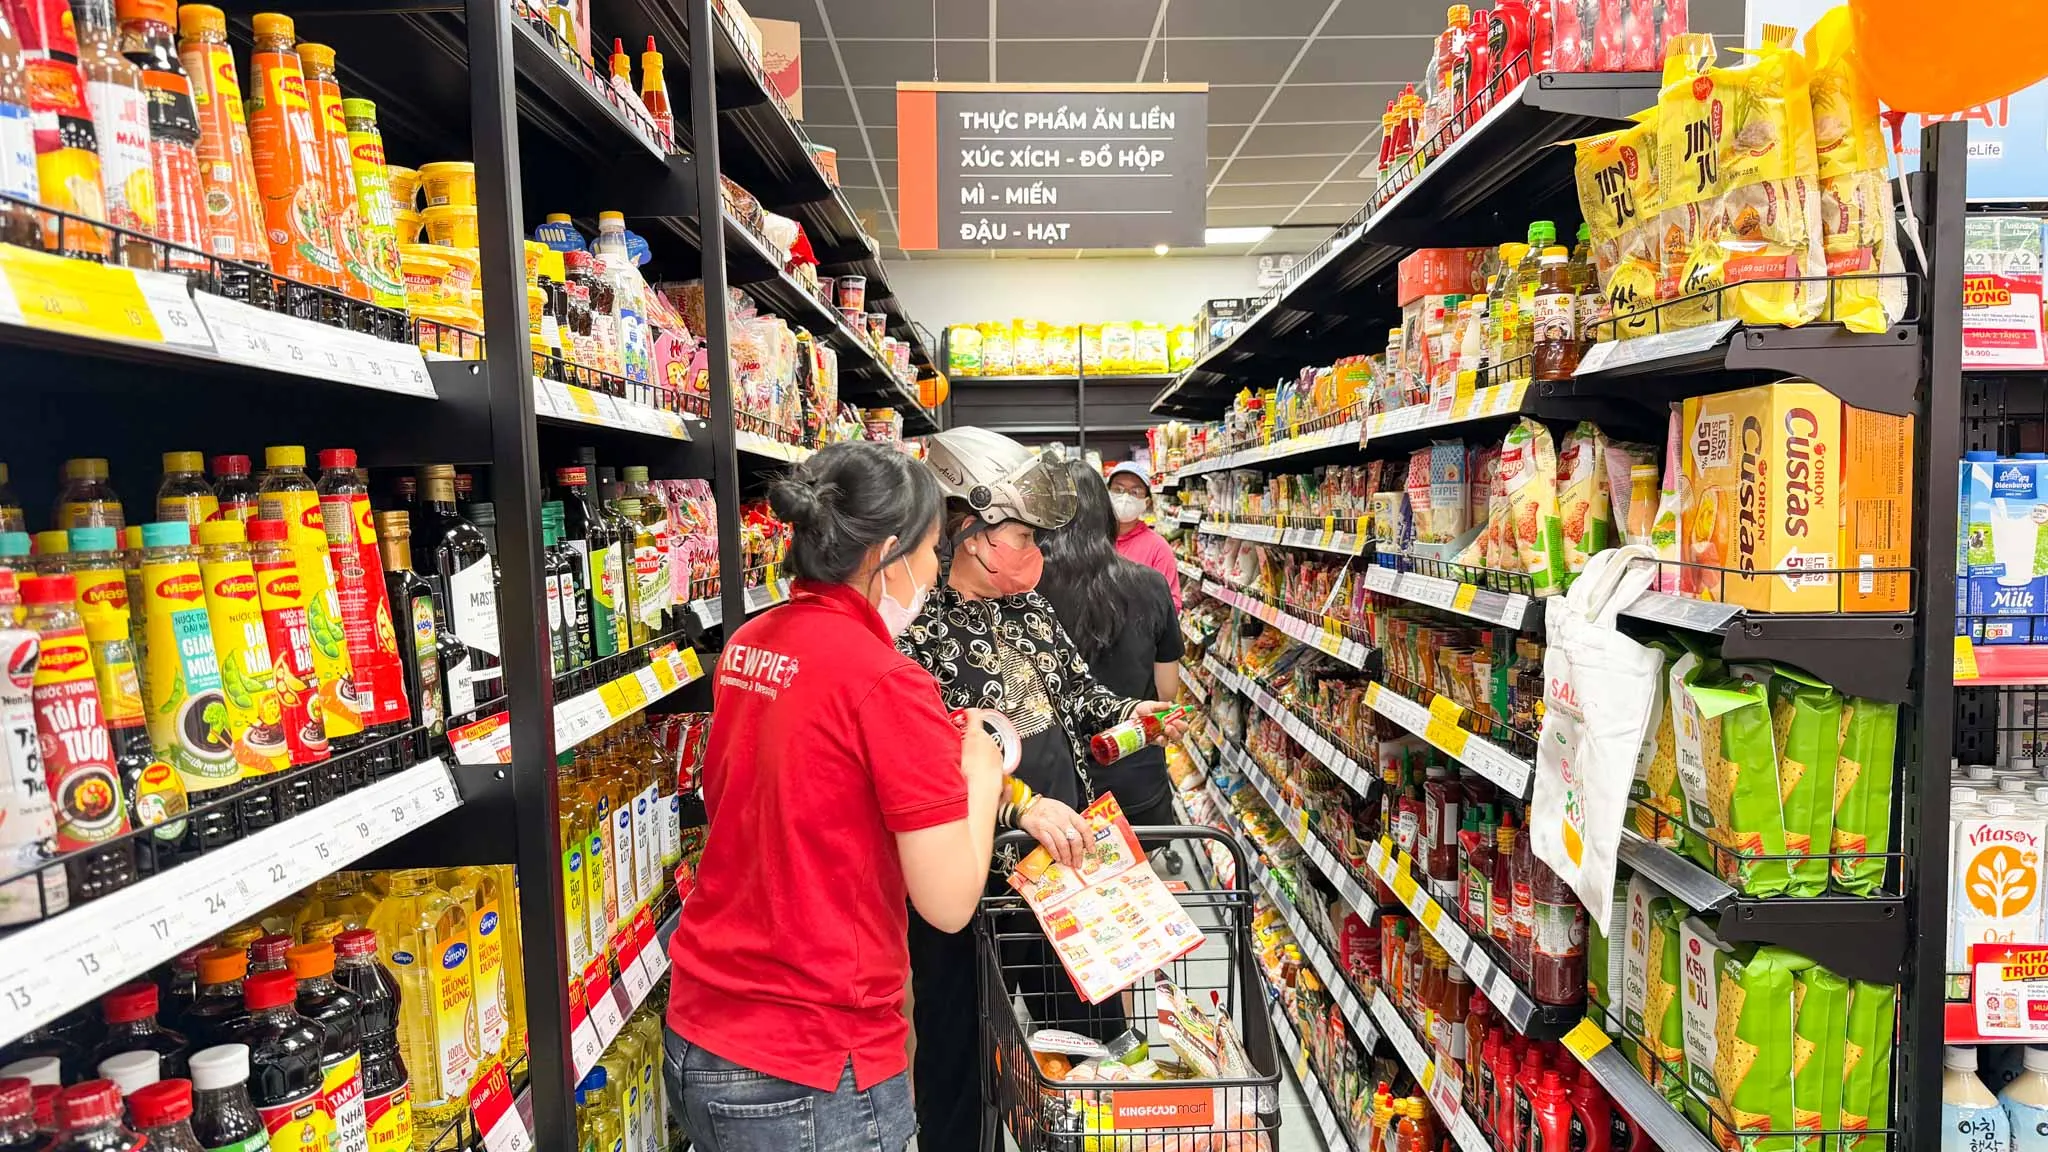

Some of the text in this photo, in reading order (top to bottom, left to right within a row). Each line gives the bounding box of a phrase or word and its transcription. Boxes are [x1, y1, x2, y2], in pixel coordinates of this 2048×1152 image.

[960, 104, 1175, 134] THỰC PHẨM ĂN LIỀN
[1684, 115, 1712, 162] JIN
[960, 145, 1005, 167] XÚC
[1009, 145, 1060, 168] XÍCH
[1079, 143, 1113, 168] ĐỒ
[1118, 144, 1165, 172] HỘP
[1594, 160, 1626, 205] JIN
[1696, 150, 1718, 194] JU
[960, 186, 985, 205] MÌ
[1005, 181, 1057, 205] MIẾN
[1611, 186, 1636, 228] JU
[960, 218, 1007, 245] ĐẬU
[1027, 222, 1071, 245] HẠT
[2010, 253, 2031, 266] A2
[167, 309, 189, 328] 65
[1697, 422, 1711, 470] 50%
[1710, 421, 1718, 461] SUGAR
[1717, 419, 1728, 461] LESS
[1784, 407, 1819, 538] Custas
[1814, 459, 1825, 506] ORION
[1994, 481, 2034, 490] Oldenburger
[1739, 415, 1763, 583] Custas
[1757, 479, 1768, 541] ORION
[1990, 590, 2036, 609] Milk
[722, 643, 790, 685] KEWPIE
[432, 786, 446, 802] 35
[391, 806, 405, 823] 29
[356, 823, 371, 840] 19
[314, 842, 330, 861] 15
[267, 863, 288, 884] 22
[204, 892, 228, 915] 24
[149, 918, 171, 941] 17
[480, 913, 499, 934] Simply
[1983, 928, 2016, 945] Oat
[76, 952, 102, 977] 13
[443, 947, 468, 967] Simply
[1685, 952, 1708, 986] KEN
[5, 986, 33, 1012] 13
[489, 1069, 506, 1096] TỐT
[372, 1128, 395, 1145] Tam
[1957, 1117, 1996, 1141] 아침
